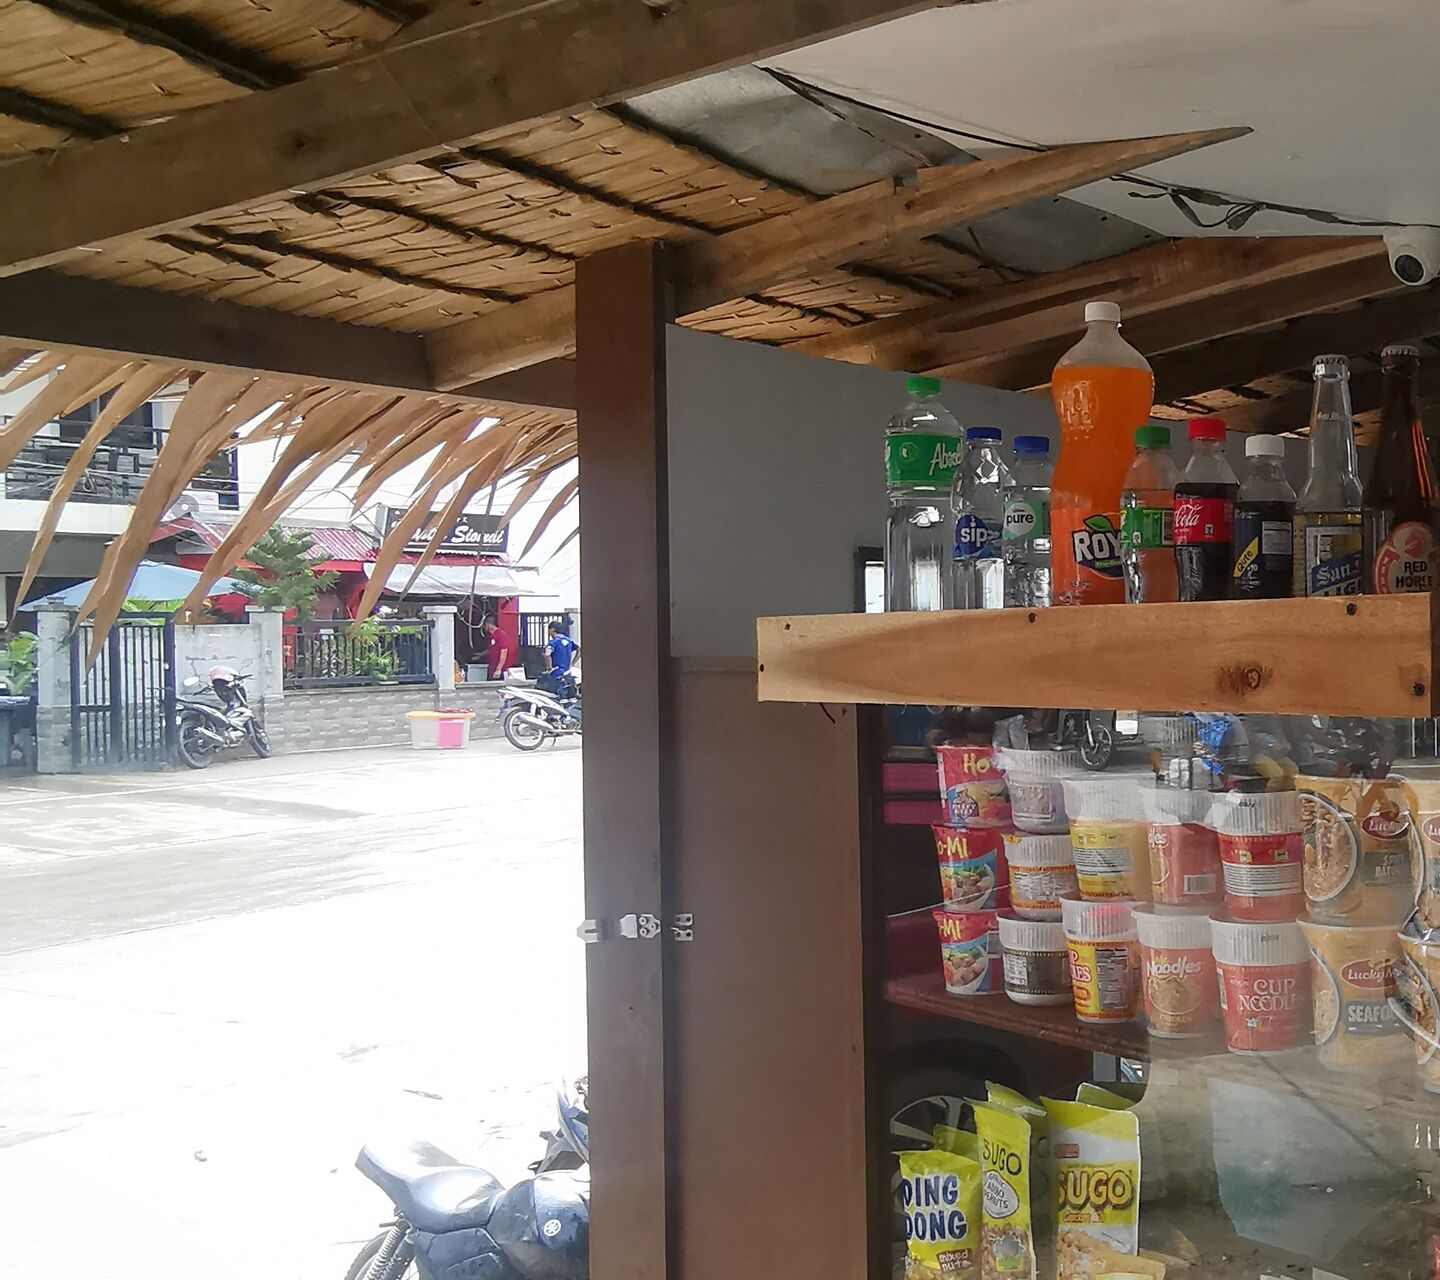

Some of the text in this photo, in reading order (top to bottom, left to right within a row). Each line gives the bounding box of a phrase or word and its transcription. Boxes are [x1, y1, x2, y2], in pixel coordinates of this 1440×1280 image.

[1006, 513, 1034, 524] pure
[961, 521, 988, 547] sip
[1404, 561, 1428, 574] RED
[1147, 956, 1202, 979] Noodles
[1348, 968, 1385, 983] Lucky
[1253, 978, 1296, 995] CUP
[983, 1139, 1022, 1176] SUGO
[938, 1250, 969, 1263] mixed
